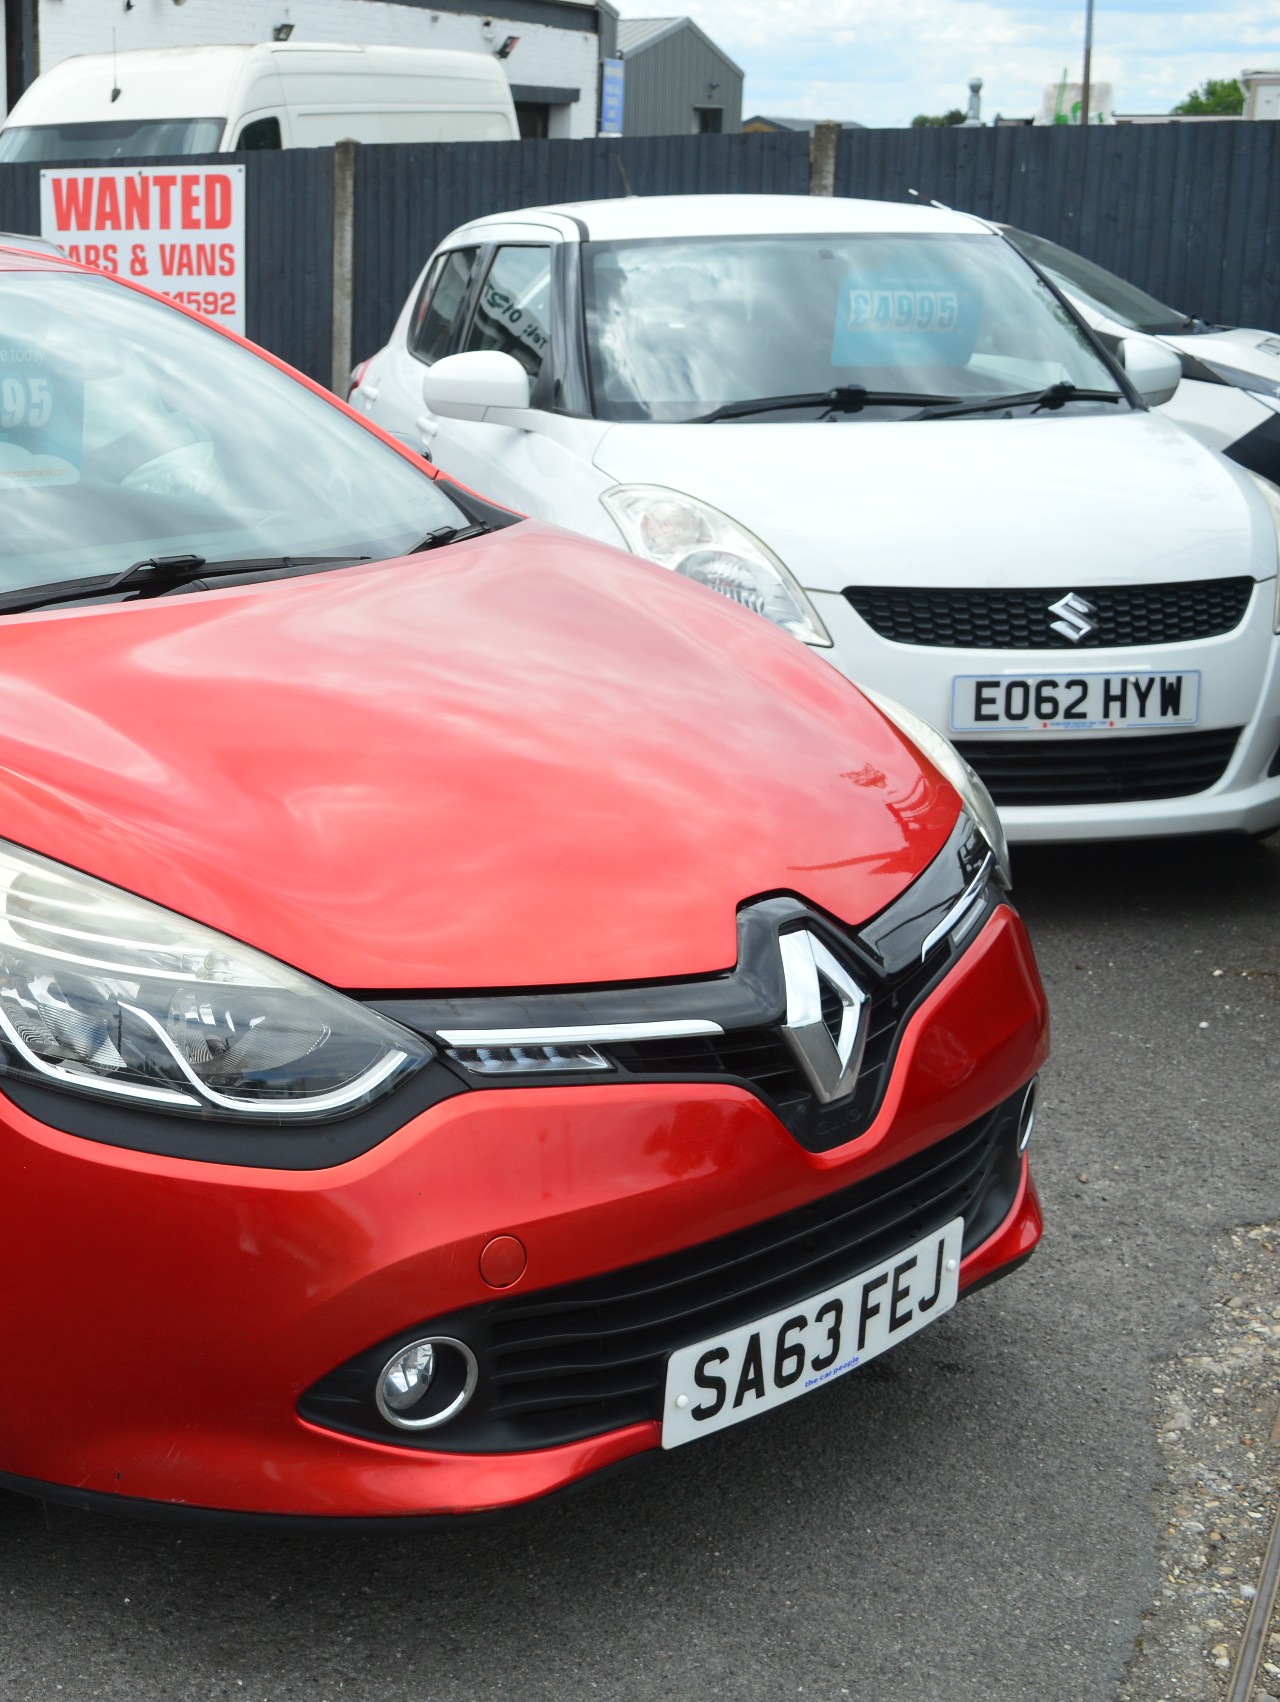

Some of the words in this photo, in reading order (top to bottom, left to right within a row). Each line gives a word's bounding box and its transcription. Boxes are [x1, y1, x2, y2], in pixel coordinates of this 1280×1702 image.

[52, 174, 232, 231] WANTED
[56, 244, 118, 275] ARS
[129, 243, 149, 276] &
[159, 243, 236, 276] VANS
[851, 293, 957, 330] £4995
[11, 347, 46, 367] today
[974, 679, 1088, 722] EO62
[1102, 676, 1182, 719] HYW
[691, 1298, 843, 1421] SA63
[857, 1238, 945, 1351] FEJ
[805, 1378, 818, 1388] the
[820, 1370, 832, 1380] car
[833, 1356, 859, 1375] people
